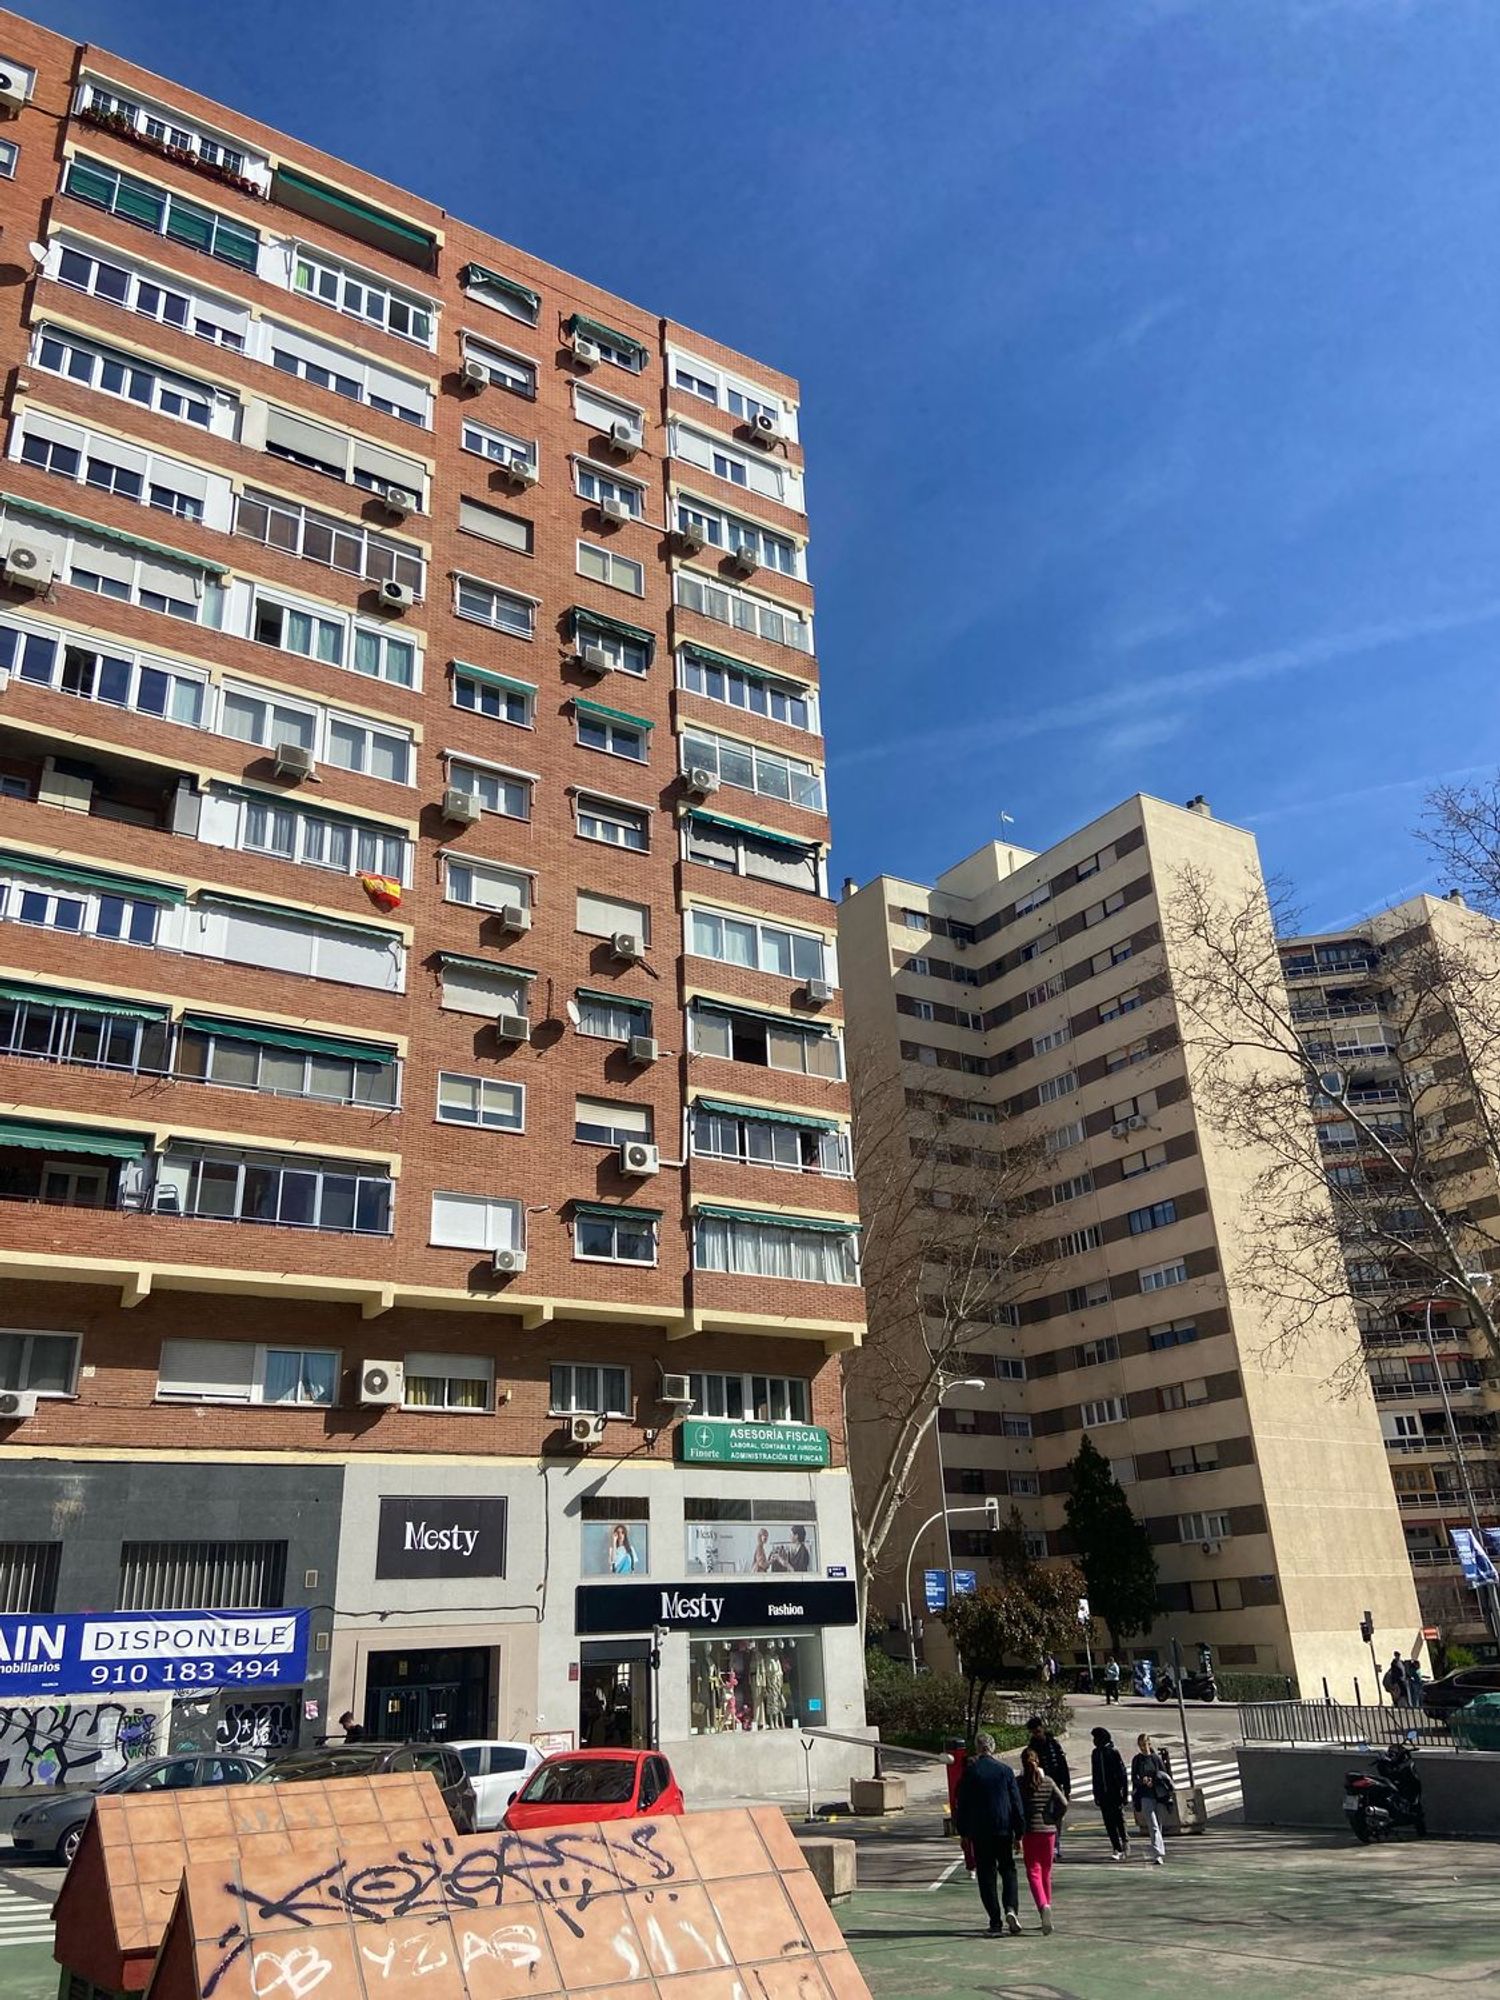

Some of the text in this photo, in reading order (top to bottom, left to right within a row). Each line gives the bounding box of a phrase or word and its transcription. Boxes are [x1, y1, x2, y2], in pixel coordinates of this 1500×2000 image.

[730, 1428, 822, 1442] ASESORÍA FISCAL
[690, 1447, 720, 1458] Finorte
[760, 1443, 791, 1451] CONTABLE
[731, 1451, 788, 1461] ADMINISTRACIÓN
[789, 1453, 798, 1461] DE
[404, 1521, 480, 1556] Mesty
[661, 1591, 725, 1623] Mesty
[768, 1603, 804, 1616] Fashion
[95, 1626, 287, 1651] DISPONIBLE
[91, 1659, 281, 1685] 910 183 494
